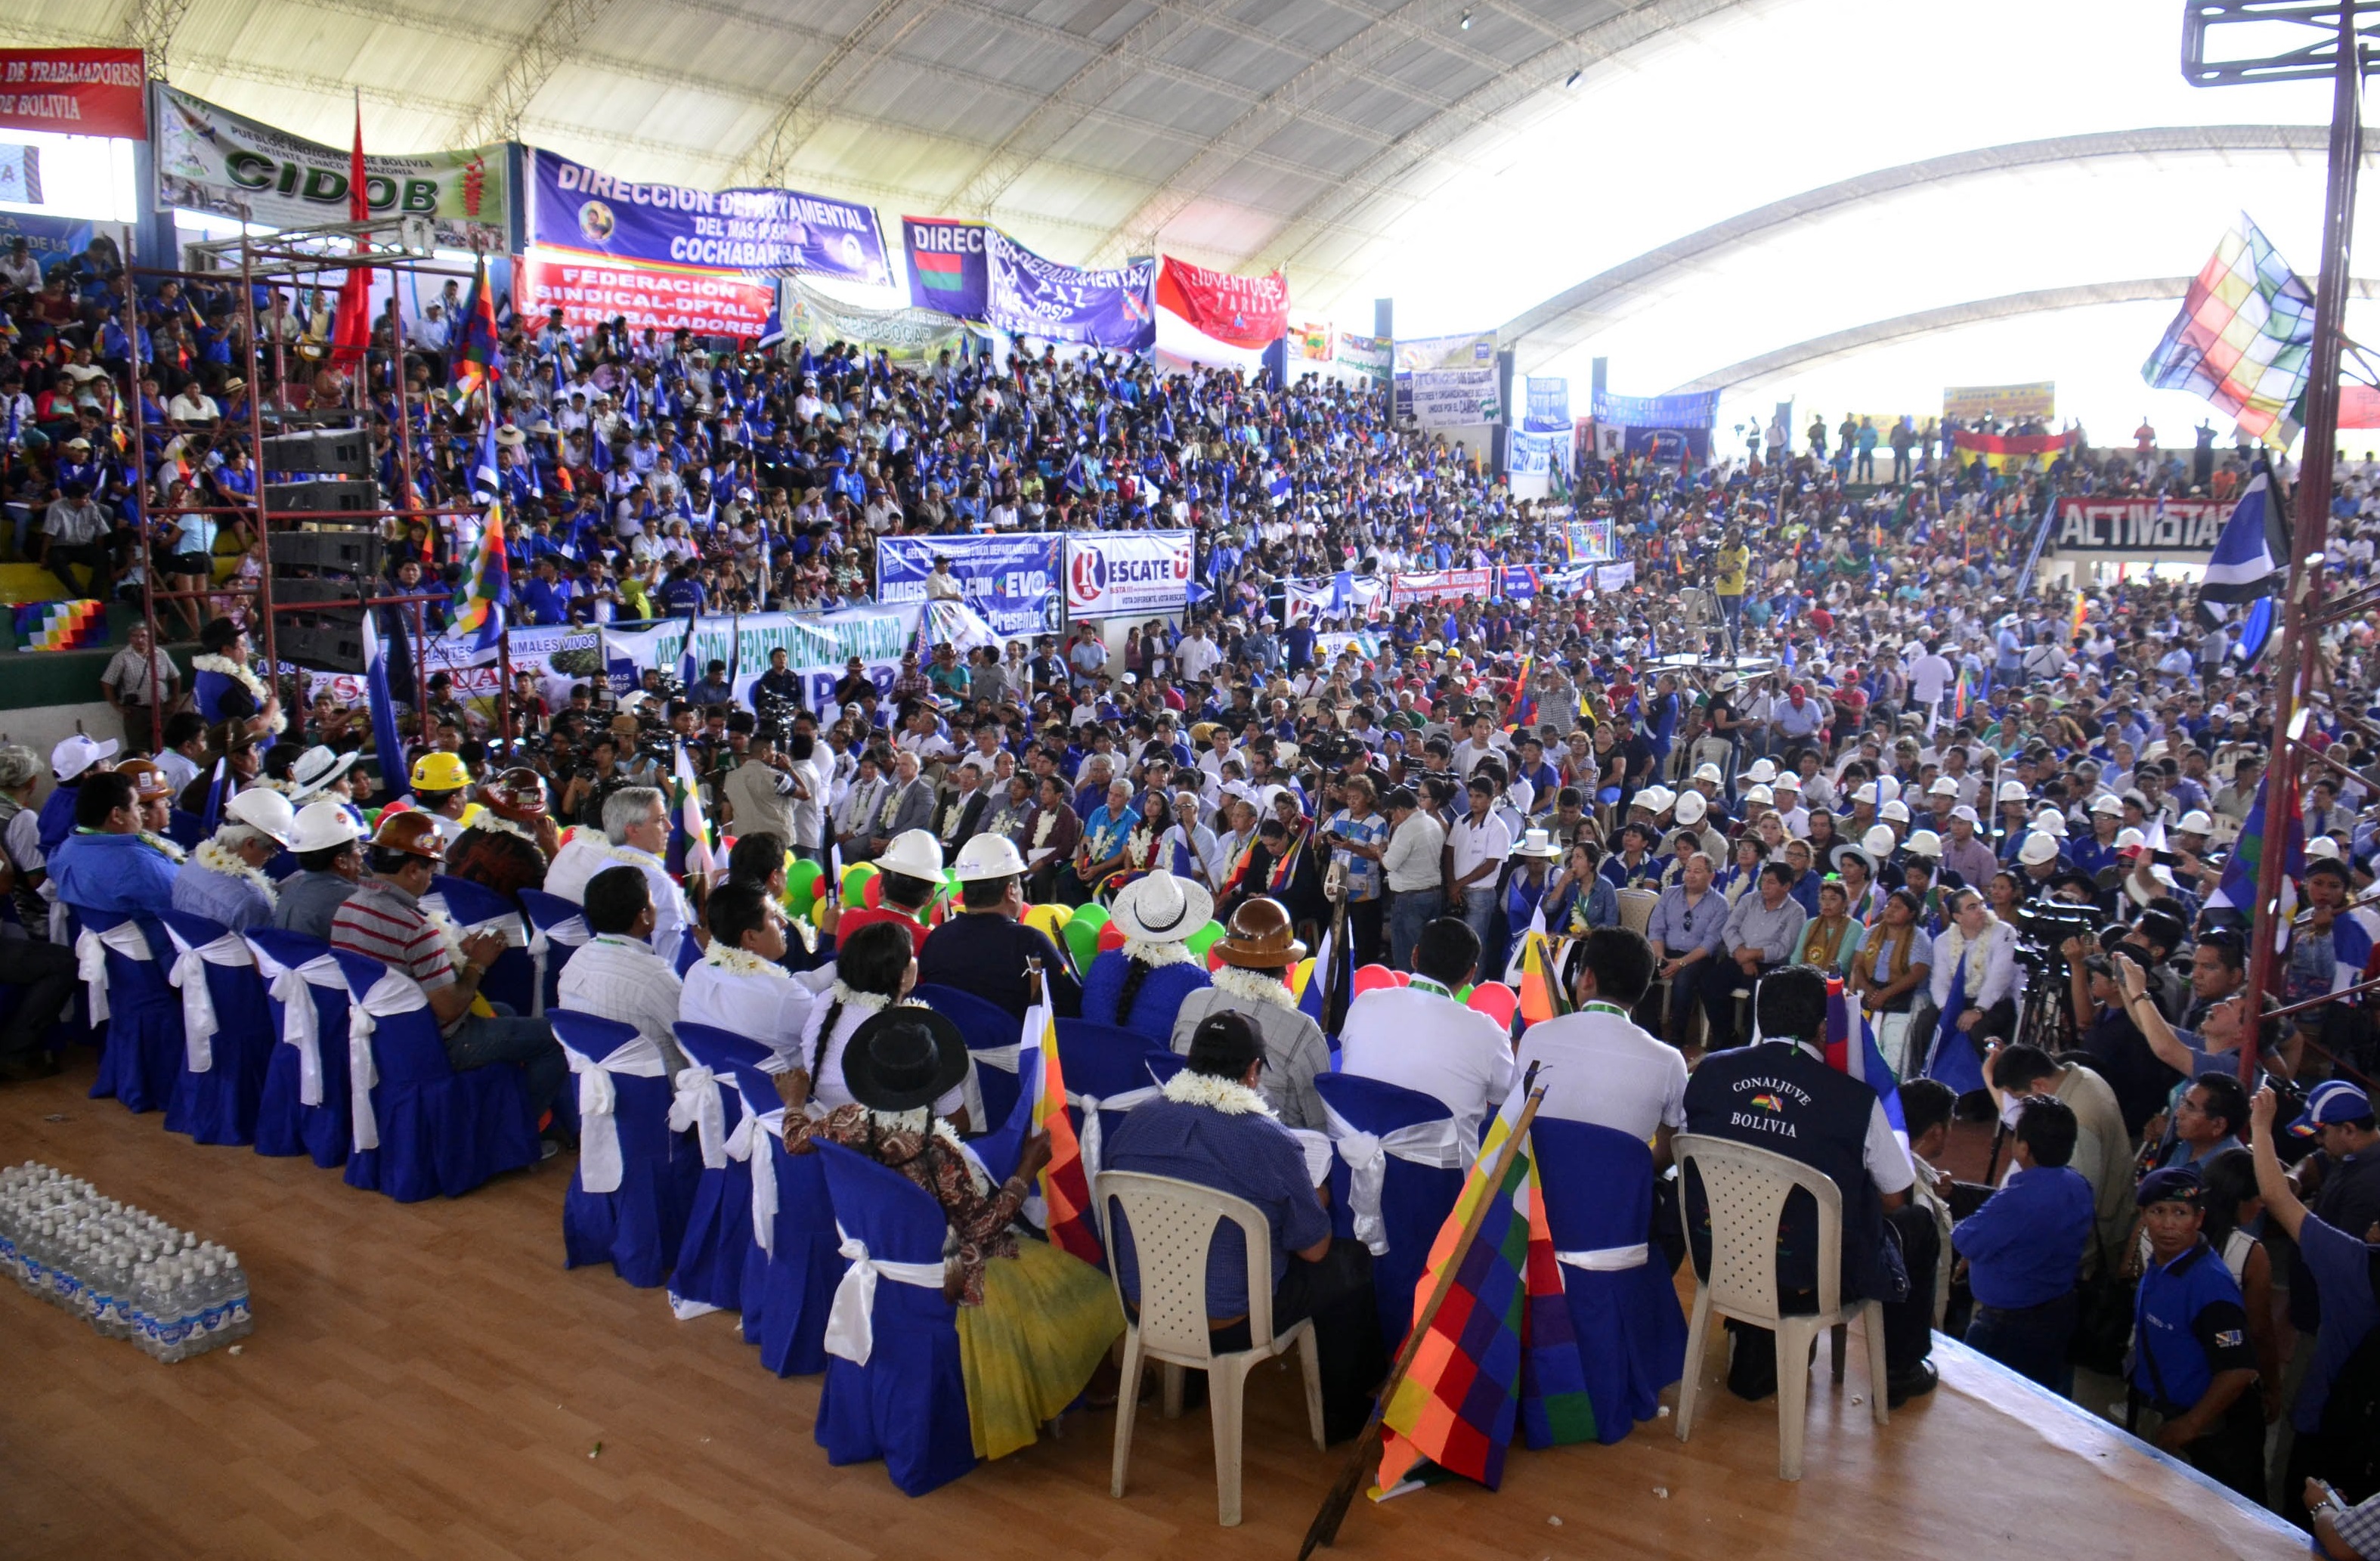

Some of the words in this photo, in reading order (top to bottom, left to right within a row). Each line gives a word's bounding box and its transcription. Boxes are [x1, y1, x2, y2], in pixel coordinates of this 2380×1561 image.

[5, 61, 27, 82] DE
[30, 61, 141, 88] TRABAJADORES
[18, 94, 81, 120] BOLIVIA
[289, 143, 354, 162] INDIGENA
[380, 157, 433, 169] BOLIVIA
[308, 158, 344, 171] CHACO
[364, 165, 414, 176] MAZONIA
[224, 150, 439, 214] CIDOB
[558, 163, 713, 214] DIRECCION
[695, 216, 725, 237] DEL
[728, 219, 756, 241] MAS
[27, 234, 48, 251] DE
[51, 237, 71, 254] LA
[670, 235, 806, 267] COCHABAMBA
[562, 268, 738, 299] FEDERACION
[995, 259, 1018, 287] LA
[1034, 279, 1086, 308] PAZ
[1191, 267, 1283, 299] JUVENTUDES
[565, 305, 768, 336] TRABAJADORES
[1568, 523, 1609, 537] DISTRITO
[989, 544, 1039, 556] DEPARTAMENTAL
[965, 577, 992, 597] CON
[1006, 570, 1046, 599] EVO
[988, 608, 1041, 632] Presente
[508, 636, 559, 655] NIMALES
[562, 633, 598, 649] VIVOS
[655, 633, 728, 680] DIRCION
[738, 626, 831, 674] EPARTAMENTAL
[834, 621, 871, 664] SANTA
[874, 617, 902, 660] CRUZ
[1732, 1076, 1812, 1107] CONALJUVE
[1730, 1111, 1797, 1139] BOLIVIA
